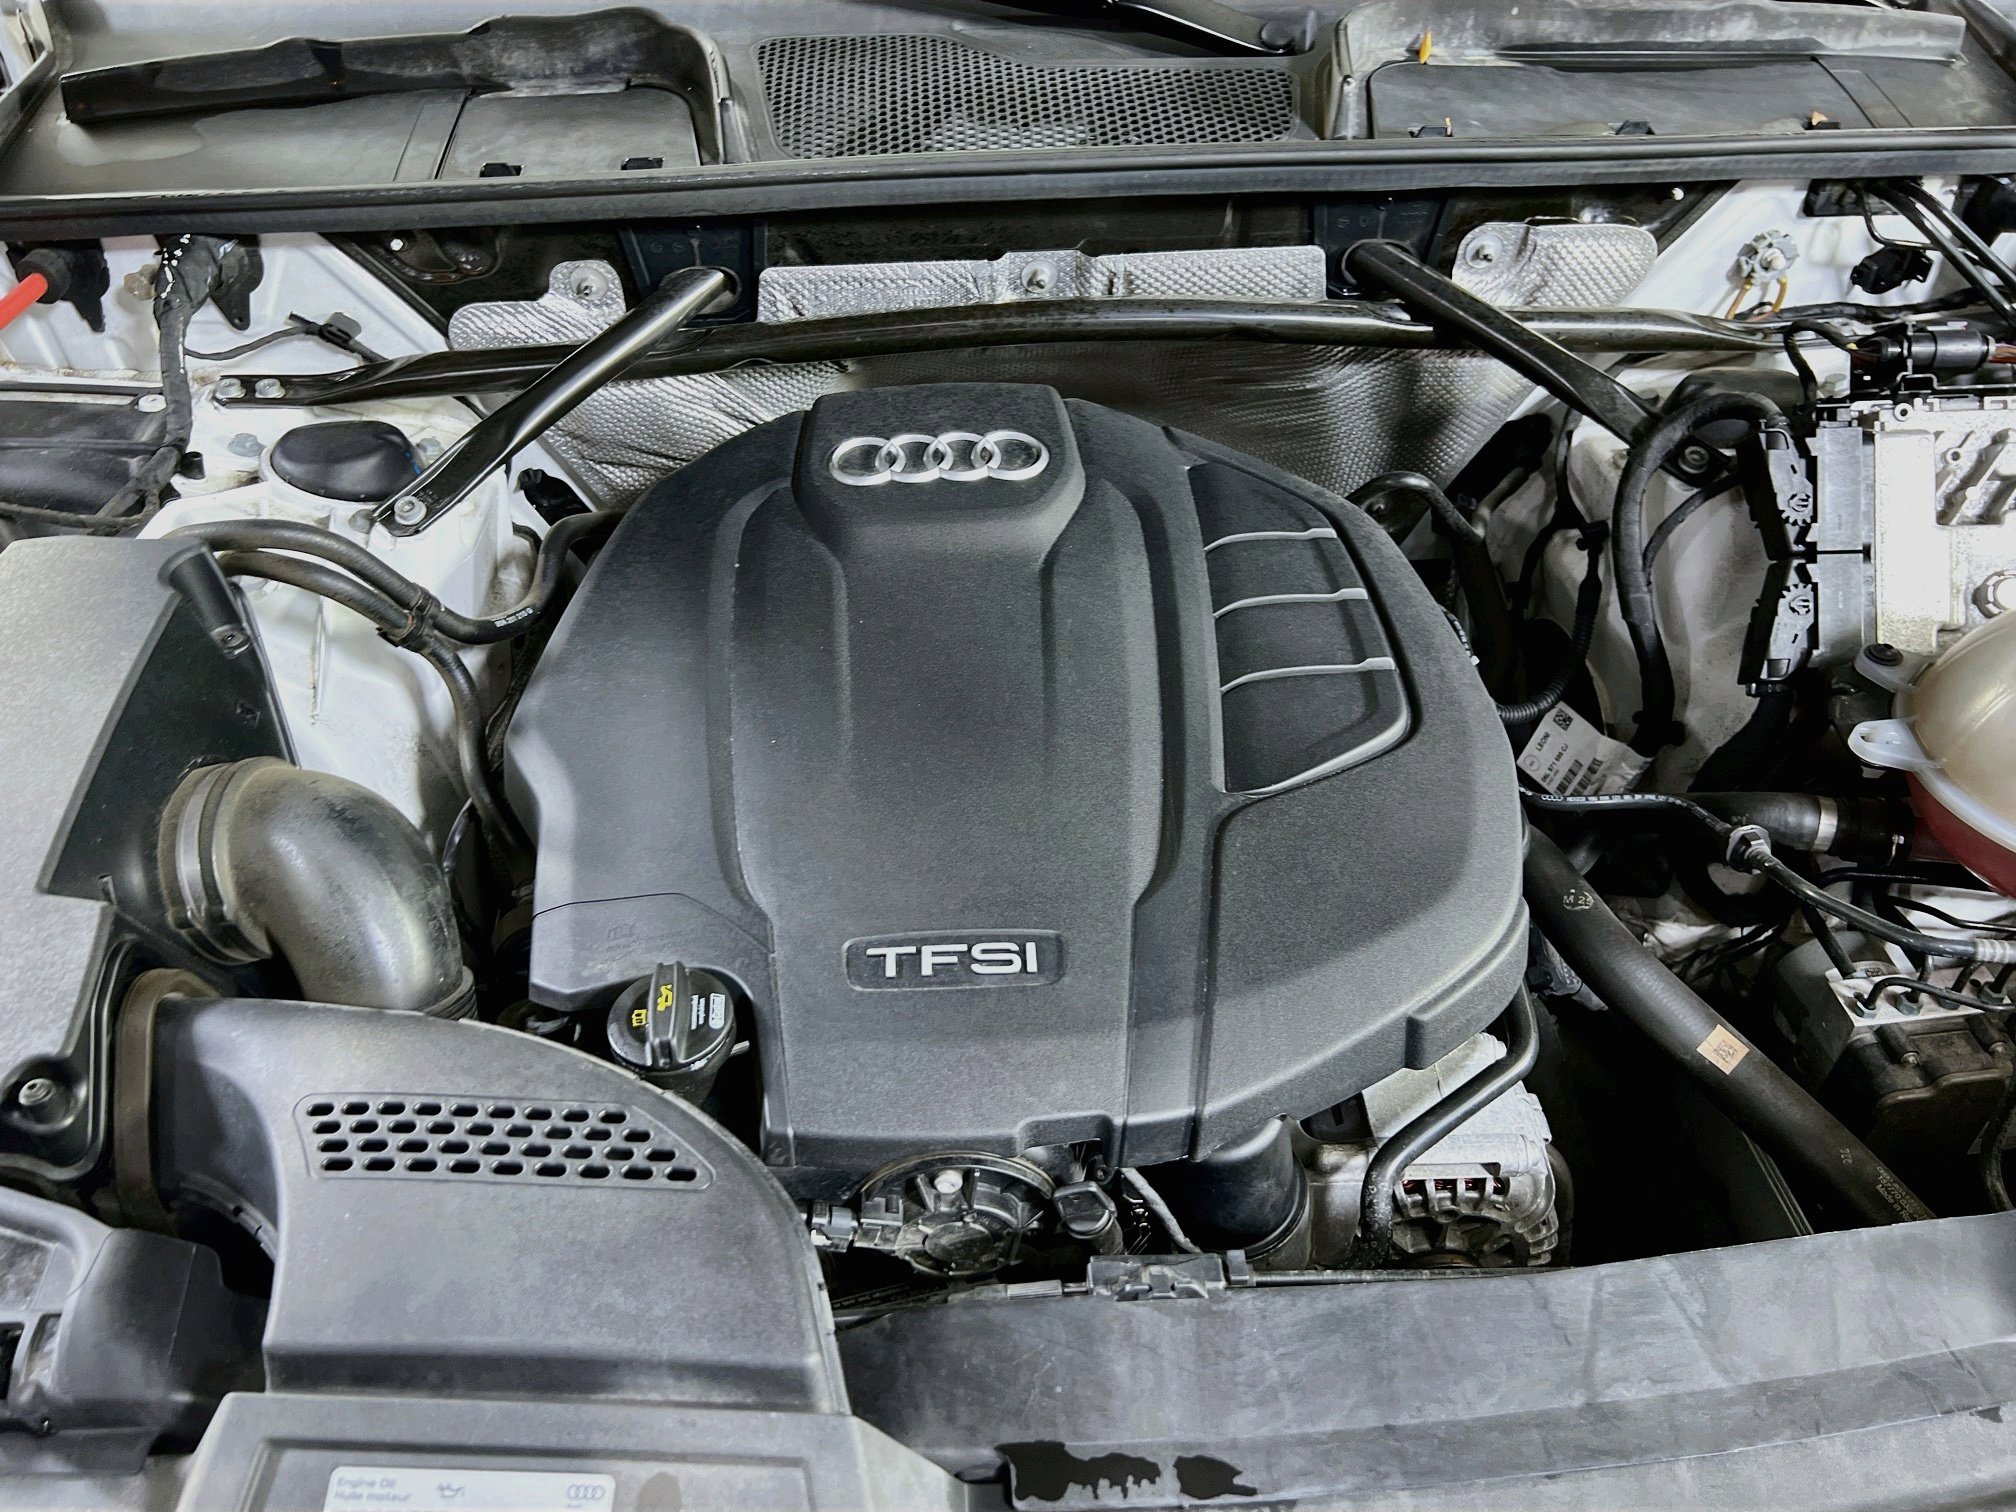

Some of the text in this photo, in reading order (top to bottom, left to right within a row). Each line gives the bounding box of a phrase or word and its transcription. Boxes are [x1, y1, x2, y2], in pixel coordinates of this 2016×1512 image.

[1535, 732, 1550, 751] LEONI
[1563, 895, 1574, 904] M
[866, 941, 1038, 979] TFSI
[336, 1476, 397, 1489] Engine Oil
